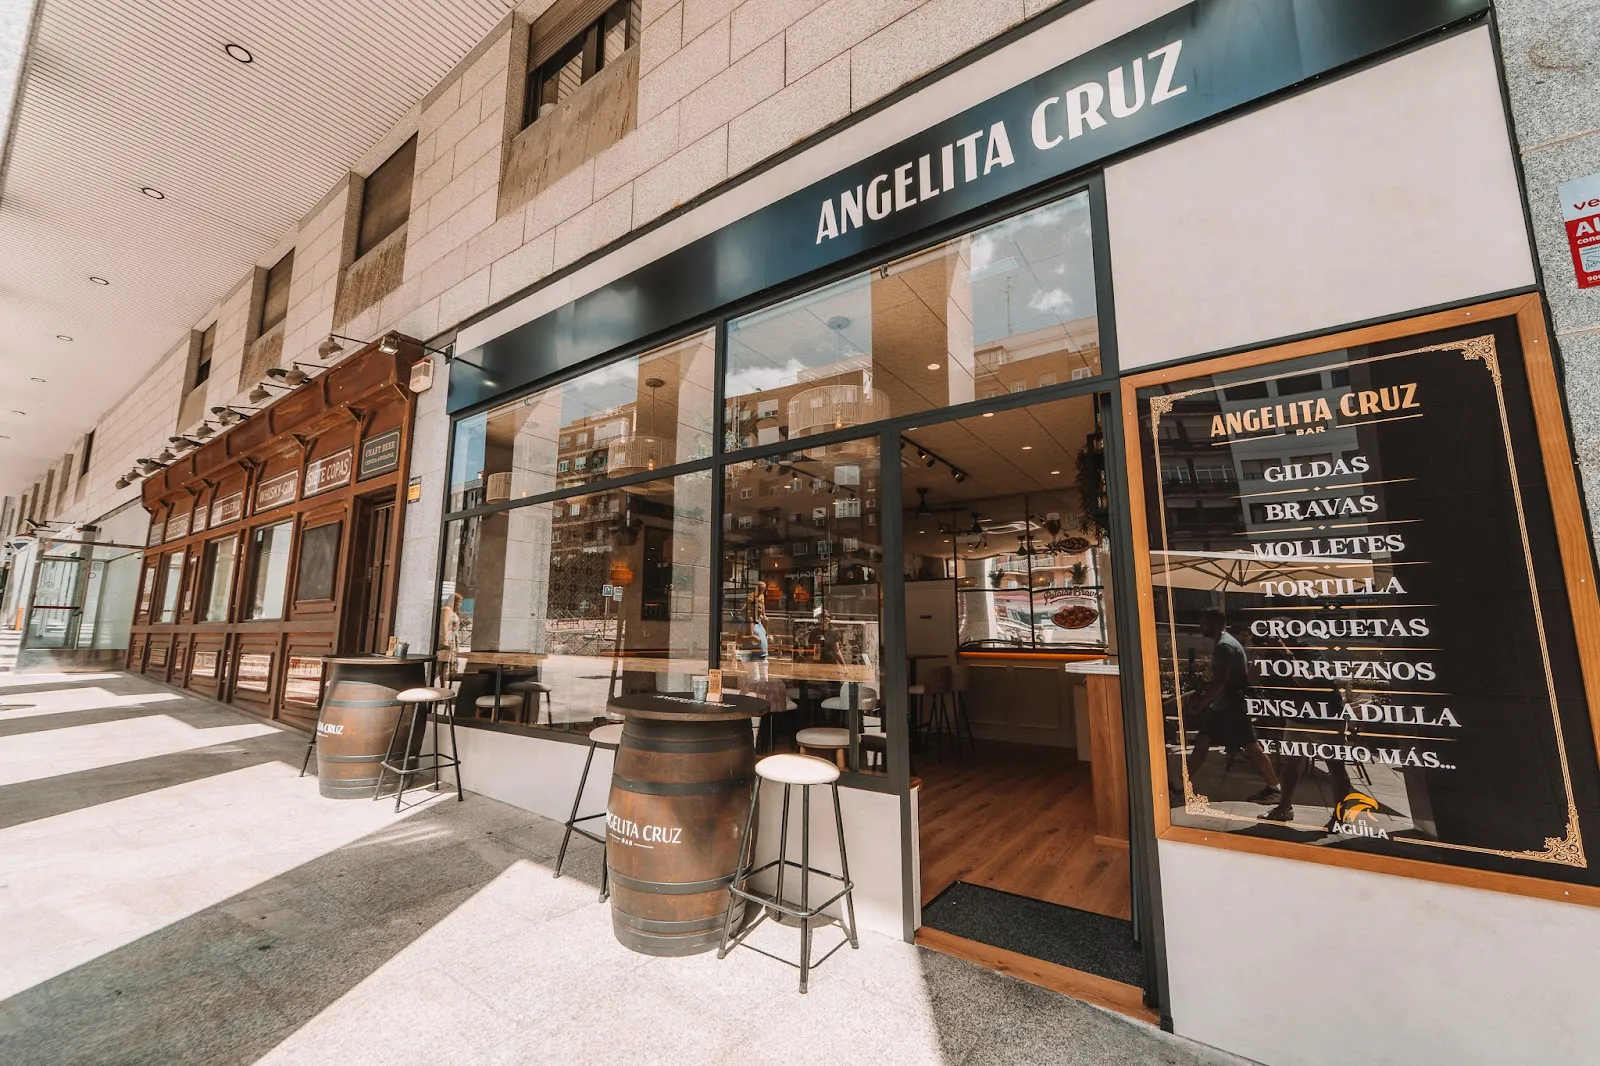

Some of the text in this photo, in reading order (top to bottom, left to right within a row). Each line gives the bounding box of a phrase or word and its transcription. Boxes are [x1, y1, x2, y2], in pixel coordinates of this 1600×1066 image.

[816, 40, 1188, 245] ANGELITA CRUZ
[1210, 382, 1421, 438] ANGELITA CRUZ
[1295, 425, 1326, 437] BAR
[381, 440, 396, 452] BEER
[326, 458, 349, 481] COPAS
[1264, 455, 1370, 483] GILDAS
[1264, 495, 1379, 522] BRAVAS
[1251, 534, 1406, 560] MOLLETES
[1260, 576, 1408, 599] TORTILLA
[1250, 618, 1430, 640] CROQUETAS
[1254, 659, 1436, 682] TORREZNOS
[1245, 698, 1462, 728] ENSALADILLA
[324, 723, 345, 735] CRUZ
[1259, 739, 1457, 771] Y MUCHO MÁS...
[621, 837, 633, 846] BAR
[642, 824, 683, 845] CRUZ
